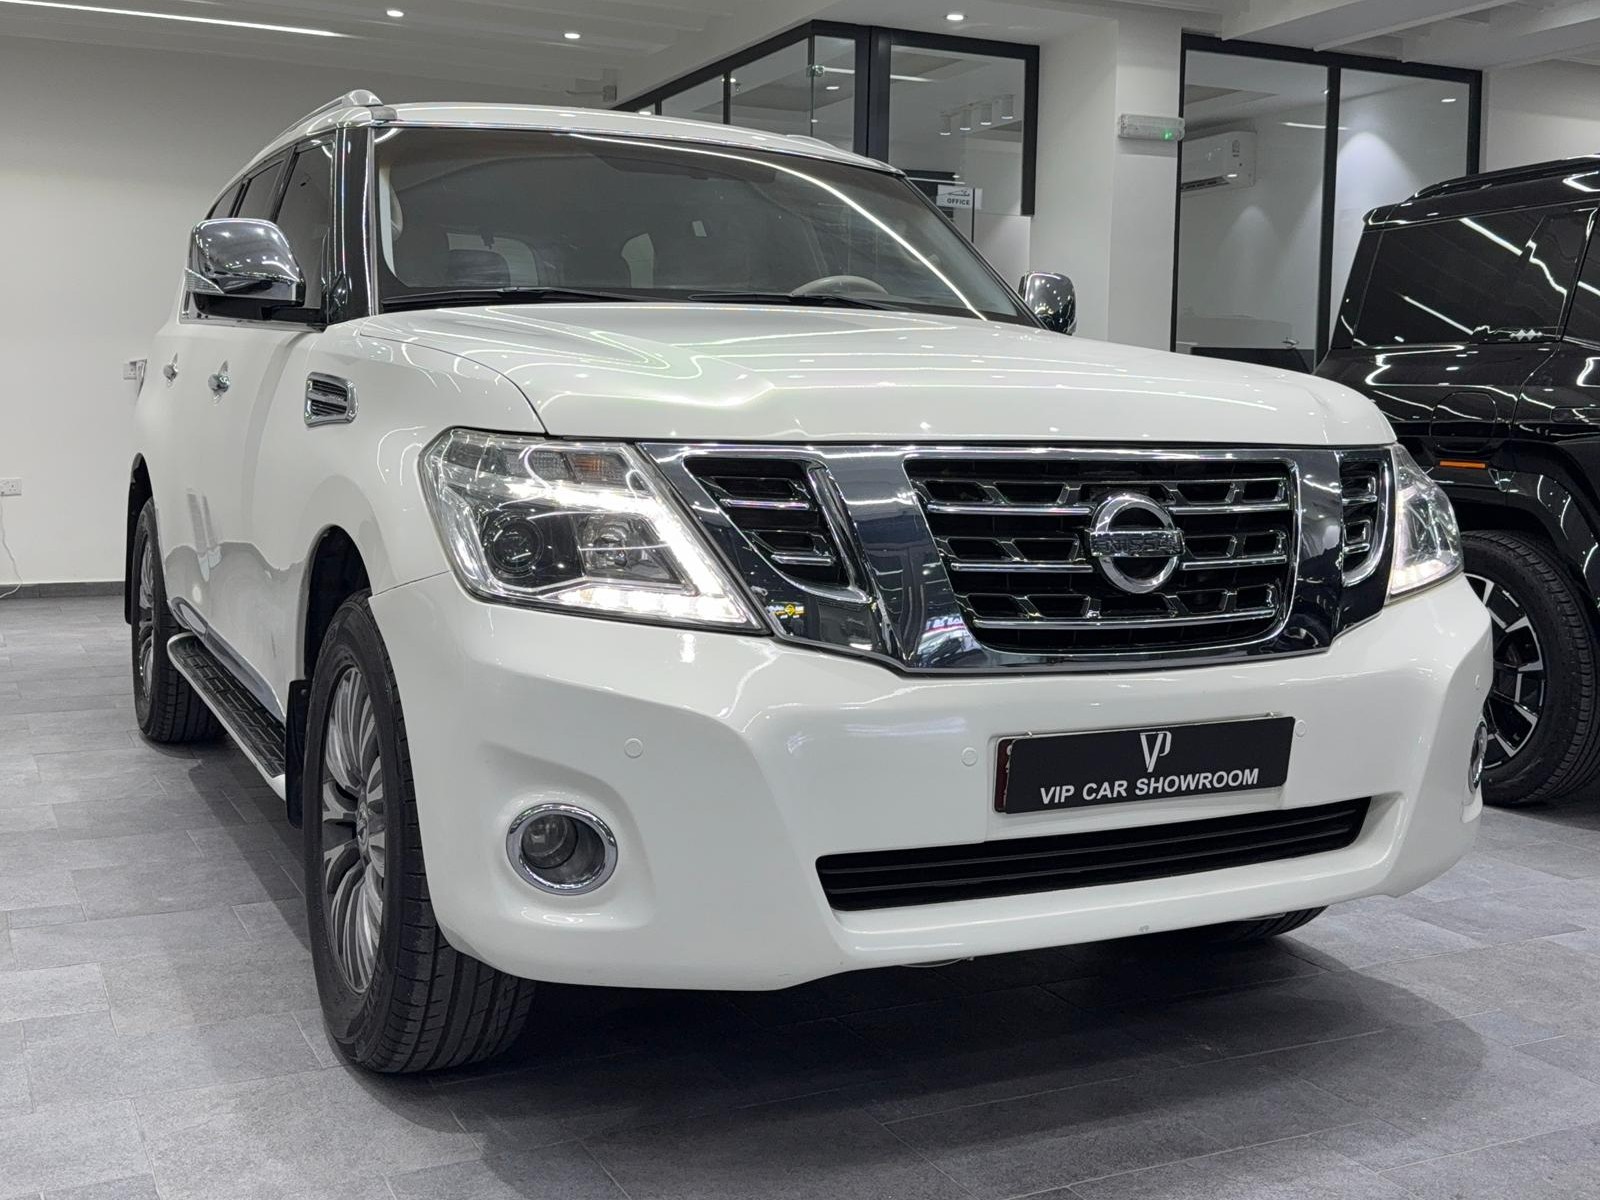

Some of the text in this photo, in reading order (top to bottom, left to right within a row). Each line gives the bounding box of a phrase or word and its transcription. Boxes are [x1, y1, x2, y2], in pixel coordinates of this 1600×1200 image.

[946, 197, 971, 206] OFFICE
[1040, 768, 1259, 804] VIP CAR SHOWROOM
